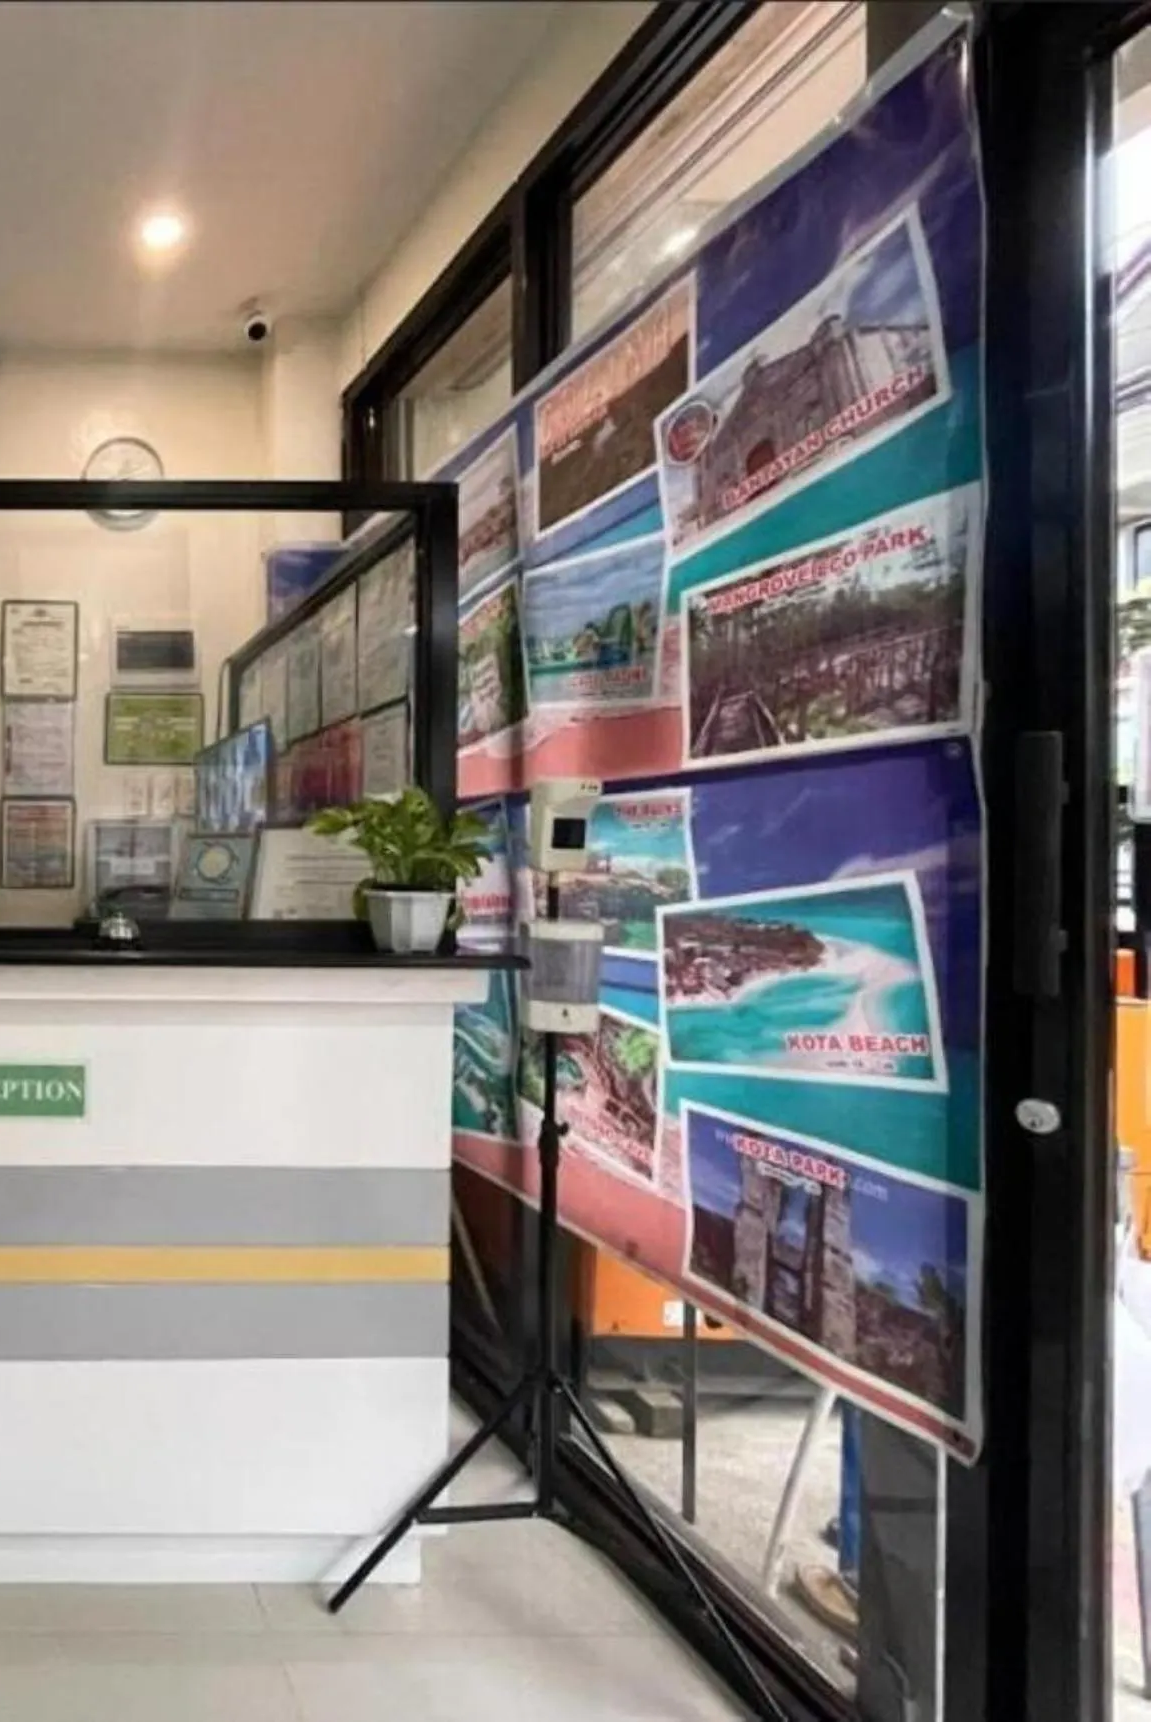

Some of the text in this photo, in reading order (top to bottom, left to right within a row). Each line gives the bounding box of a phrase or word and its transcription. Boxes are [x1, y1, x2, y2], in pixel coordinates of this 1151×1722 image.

[825, 365, 926, 438] CHURCH
[708, 560, 813, 614] MANGROVE
[816, 549, 857, 578] ECO
[861, 525, 930, 560] PARK
[786, 1033, 928, 1054] KOTA BEACH
[735, 1134, 788, 1167] KOTA
[789, 1151, 846, 1189] PARK
